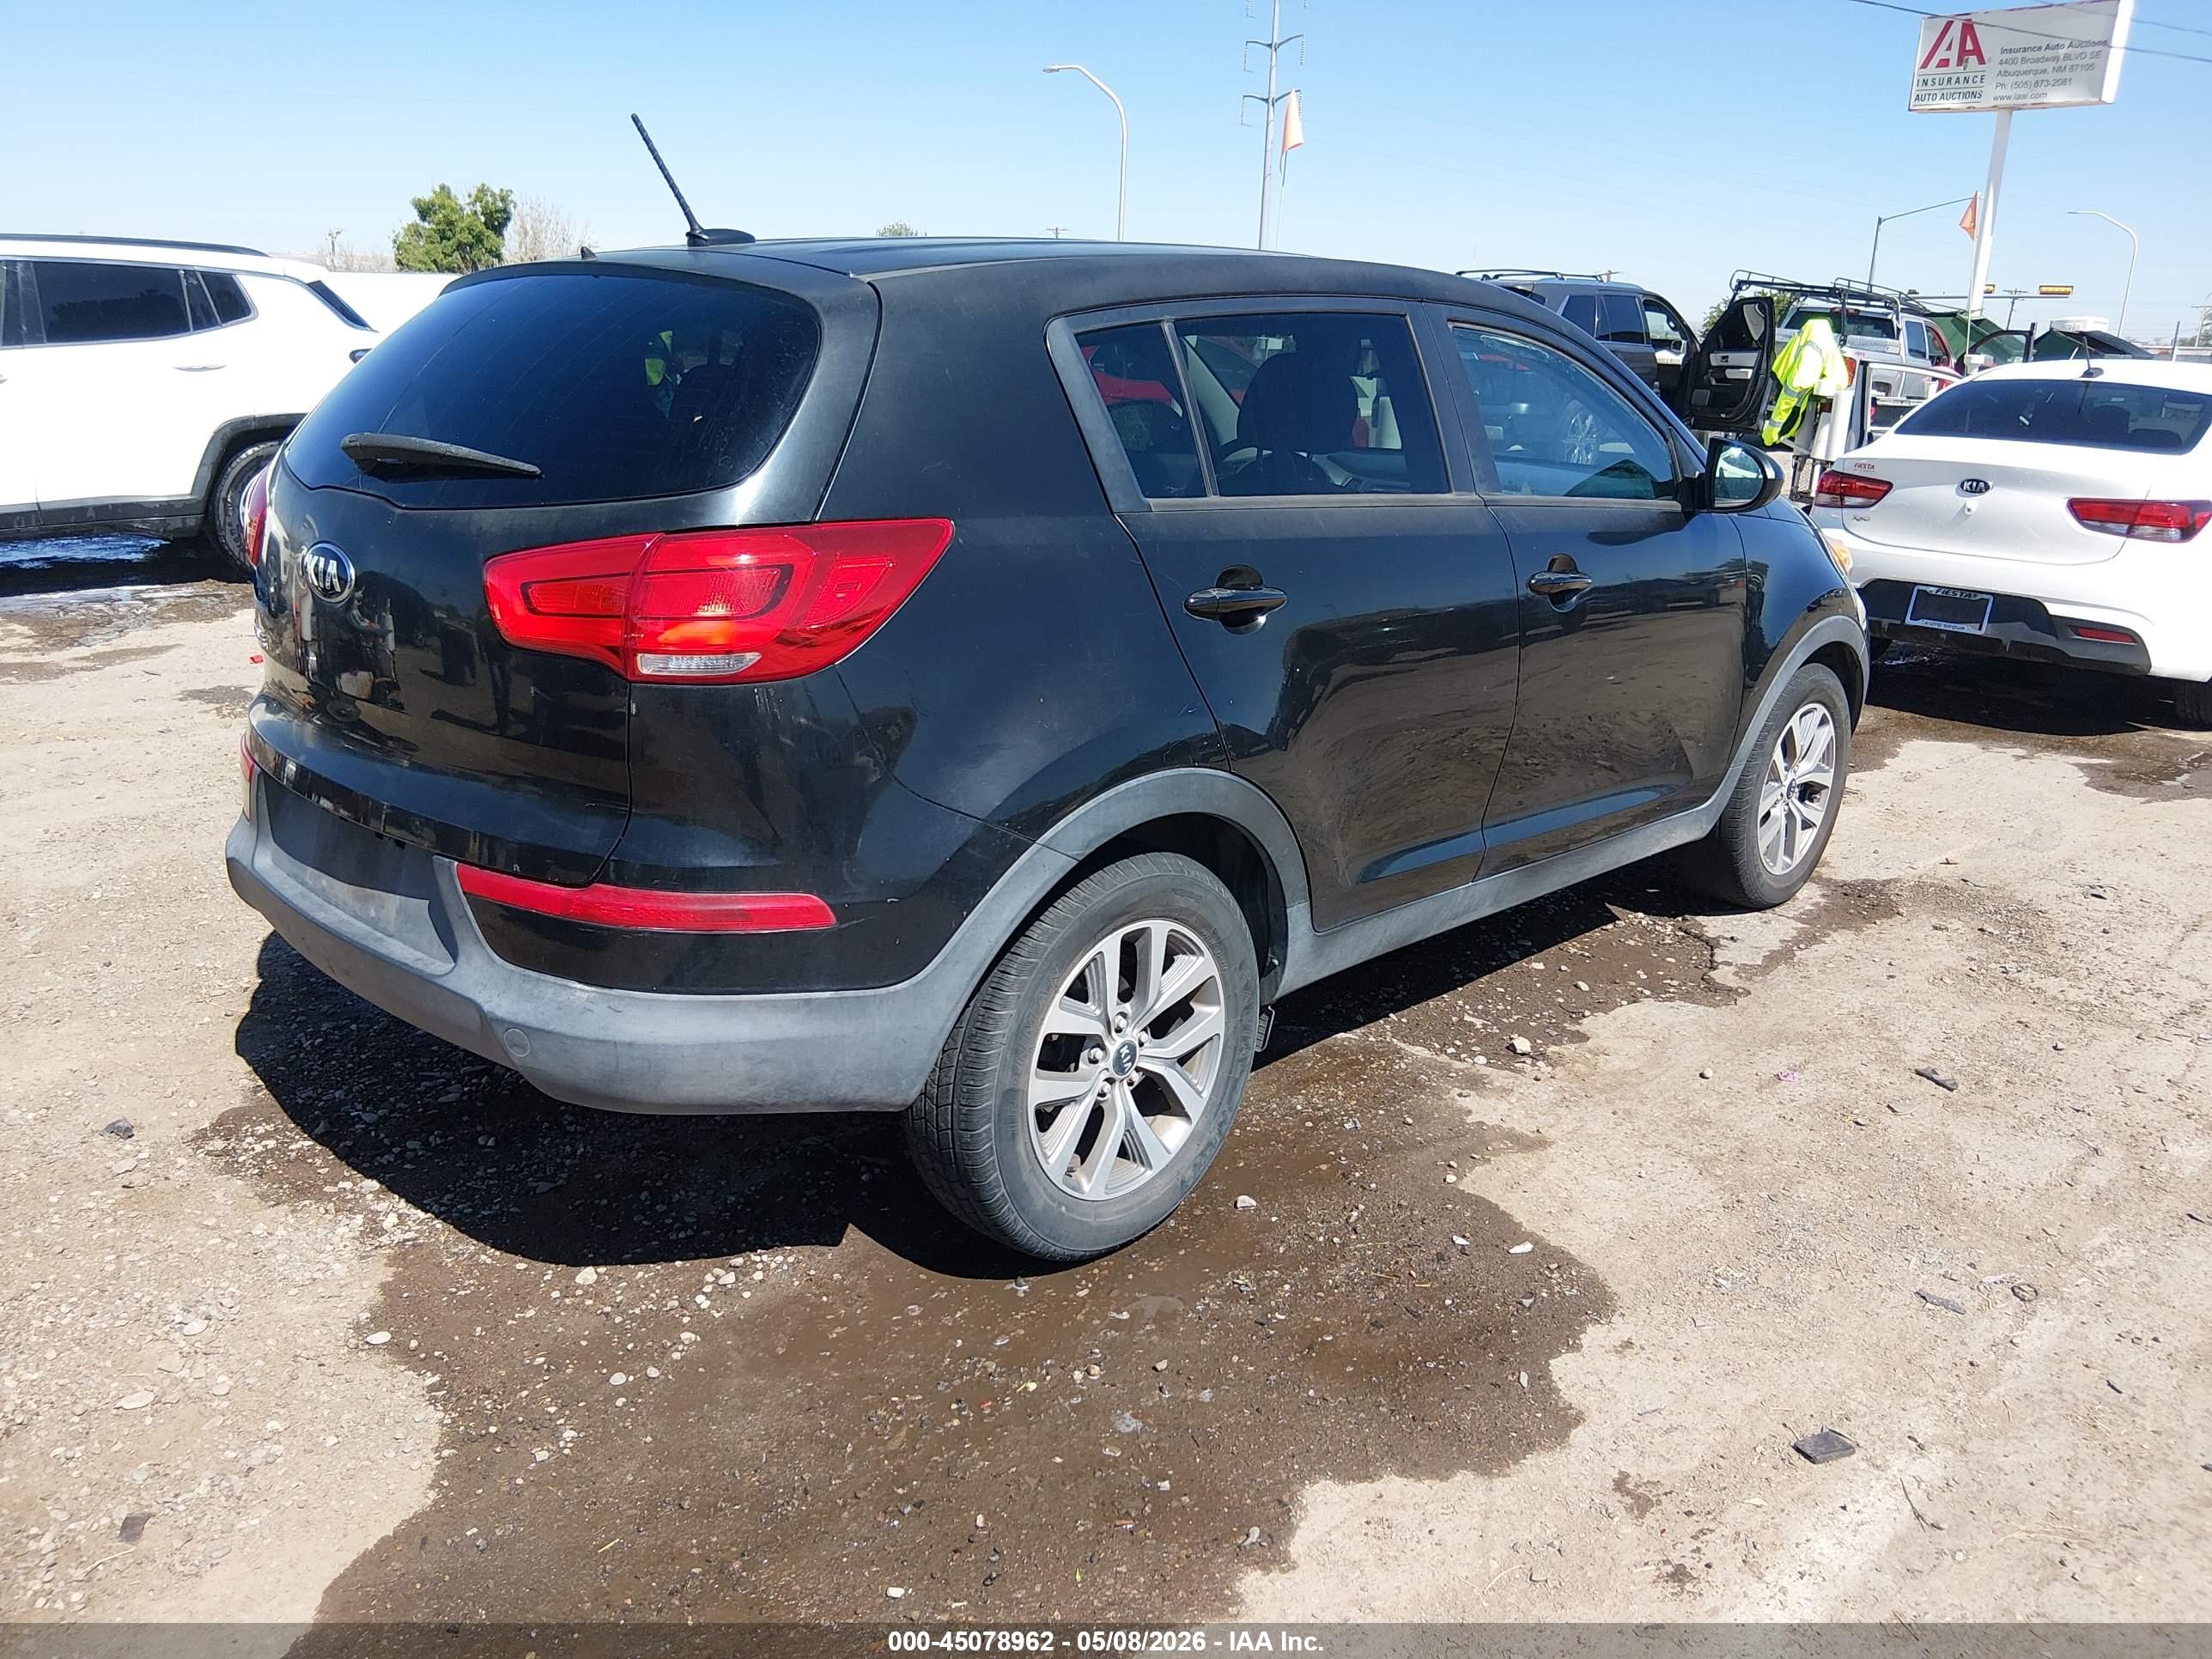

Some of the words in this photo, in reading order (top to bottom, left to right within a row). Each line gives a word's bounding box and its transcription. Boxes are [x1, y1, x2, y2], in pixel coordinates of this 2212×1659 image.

[2001, 45, 2042, 55] Insurance
[2045, 42, 2065, 52] Auto
[1999, 57, 2019, 65] 4400
[2021, 54, 2061, 65] Broadway
[2063, 52, 2087, 62] BLVD
[2089, 51, 2102, 59] SE
[2052, 64, 2067, 74] NM
[1917, 75, 1985, 87] INSURANCE
[2010, 80, 2032, 91] (505)
[1914, 93, 1937, 102] AUTO
[1939, 90, 1983, 101] AUCTIONS
[1963, 481, 1985, 492] KIA
[307, 554, 341, 592] KIA
[1936, 588, 1972, 599] FIESTA
[1120, 1044, 1132, 1073] KIA
